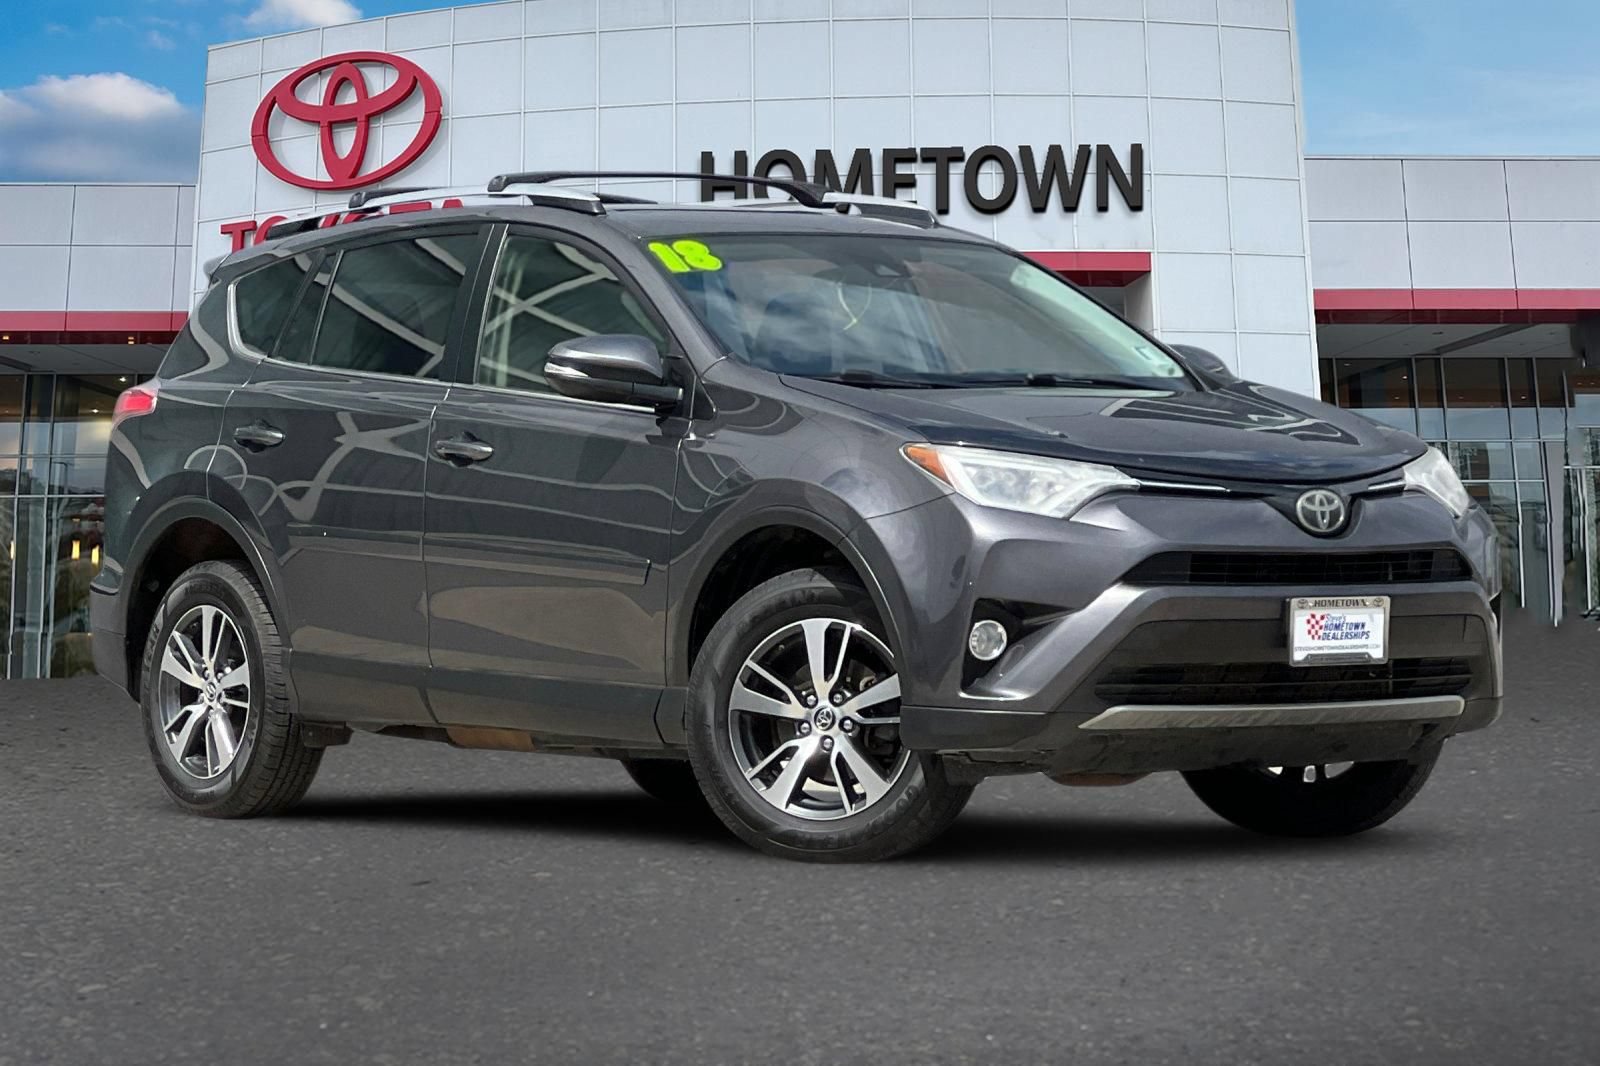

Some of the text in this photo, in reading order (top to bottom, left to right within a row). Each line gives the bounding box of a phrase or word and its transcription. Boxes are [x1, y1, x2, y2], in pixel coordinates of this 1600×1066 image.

[700, 143, 1144, 215] HOMETOWN
[647, 239, 723, 273] 18
[1313, 599, 1367, 607] HOMETOWN
[1323, 622, 1366, 631] HOMETOWN
[1321, 631, 1371, 641] DEALERSHIPS
